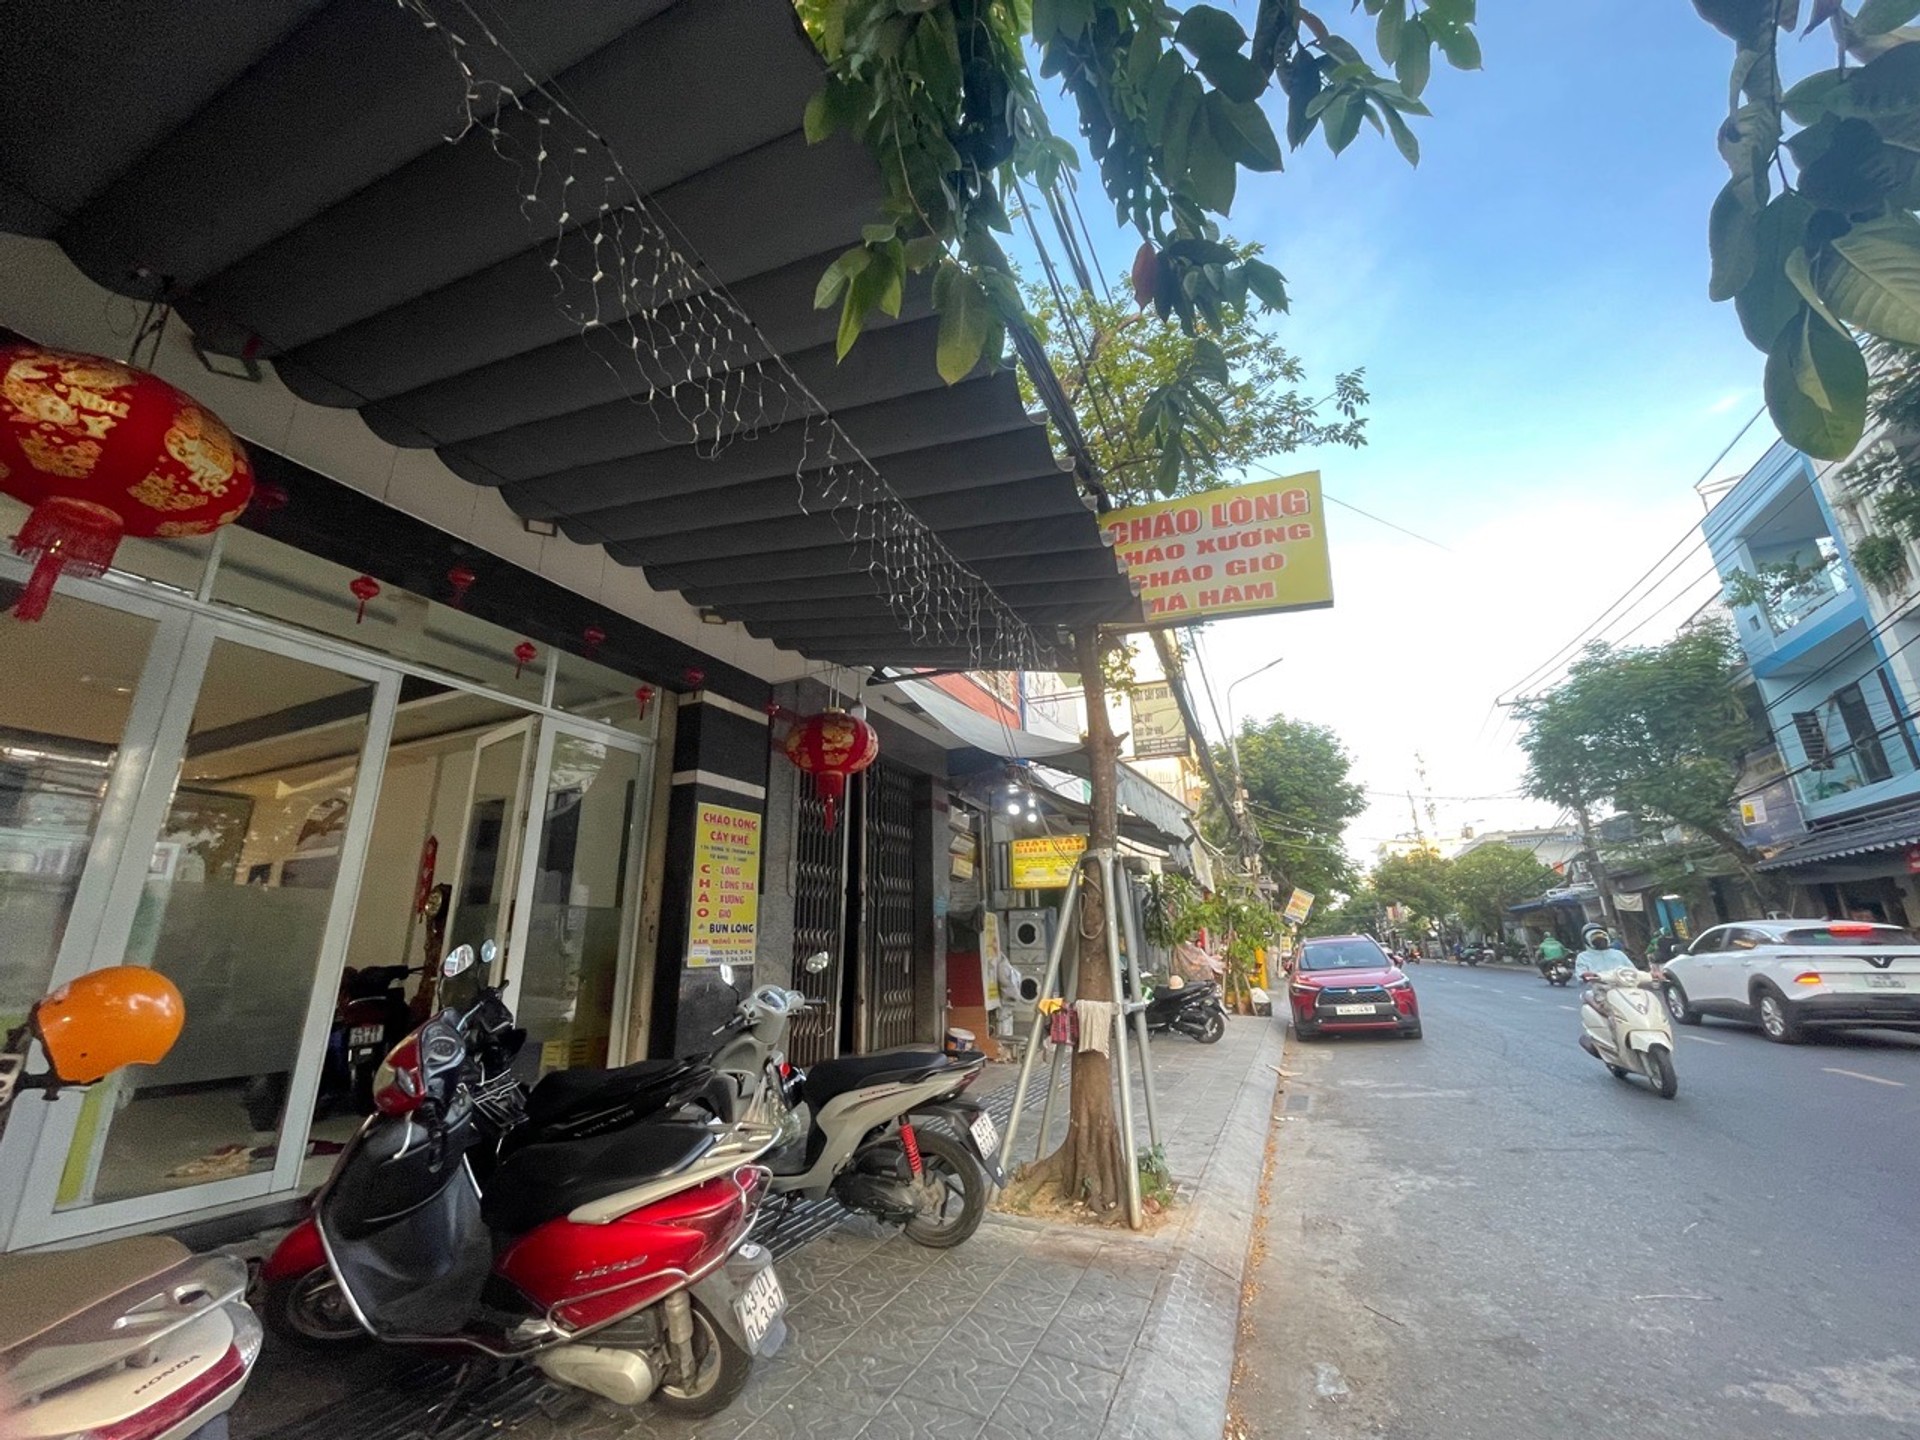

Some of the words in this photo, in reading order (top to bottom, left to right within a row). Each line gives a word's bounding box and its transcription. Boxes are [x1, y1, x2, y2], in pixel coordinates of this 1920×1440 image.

[1211, 488, 1310, 528] LÒNG
[1116, 544, 1185, 566] HÁO
[1196, 523, 1311, 556] XƯƠNG
[1225, 551, 1285, 576] GIÒ
[1198, 582, 1275, 607] HÀM
[134, 1355, 202, 1395] HONDA
